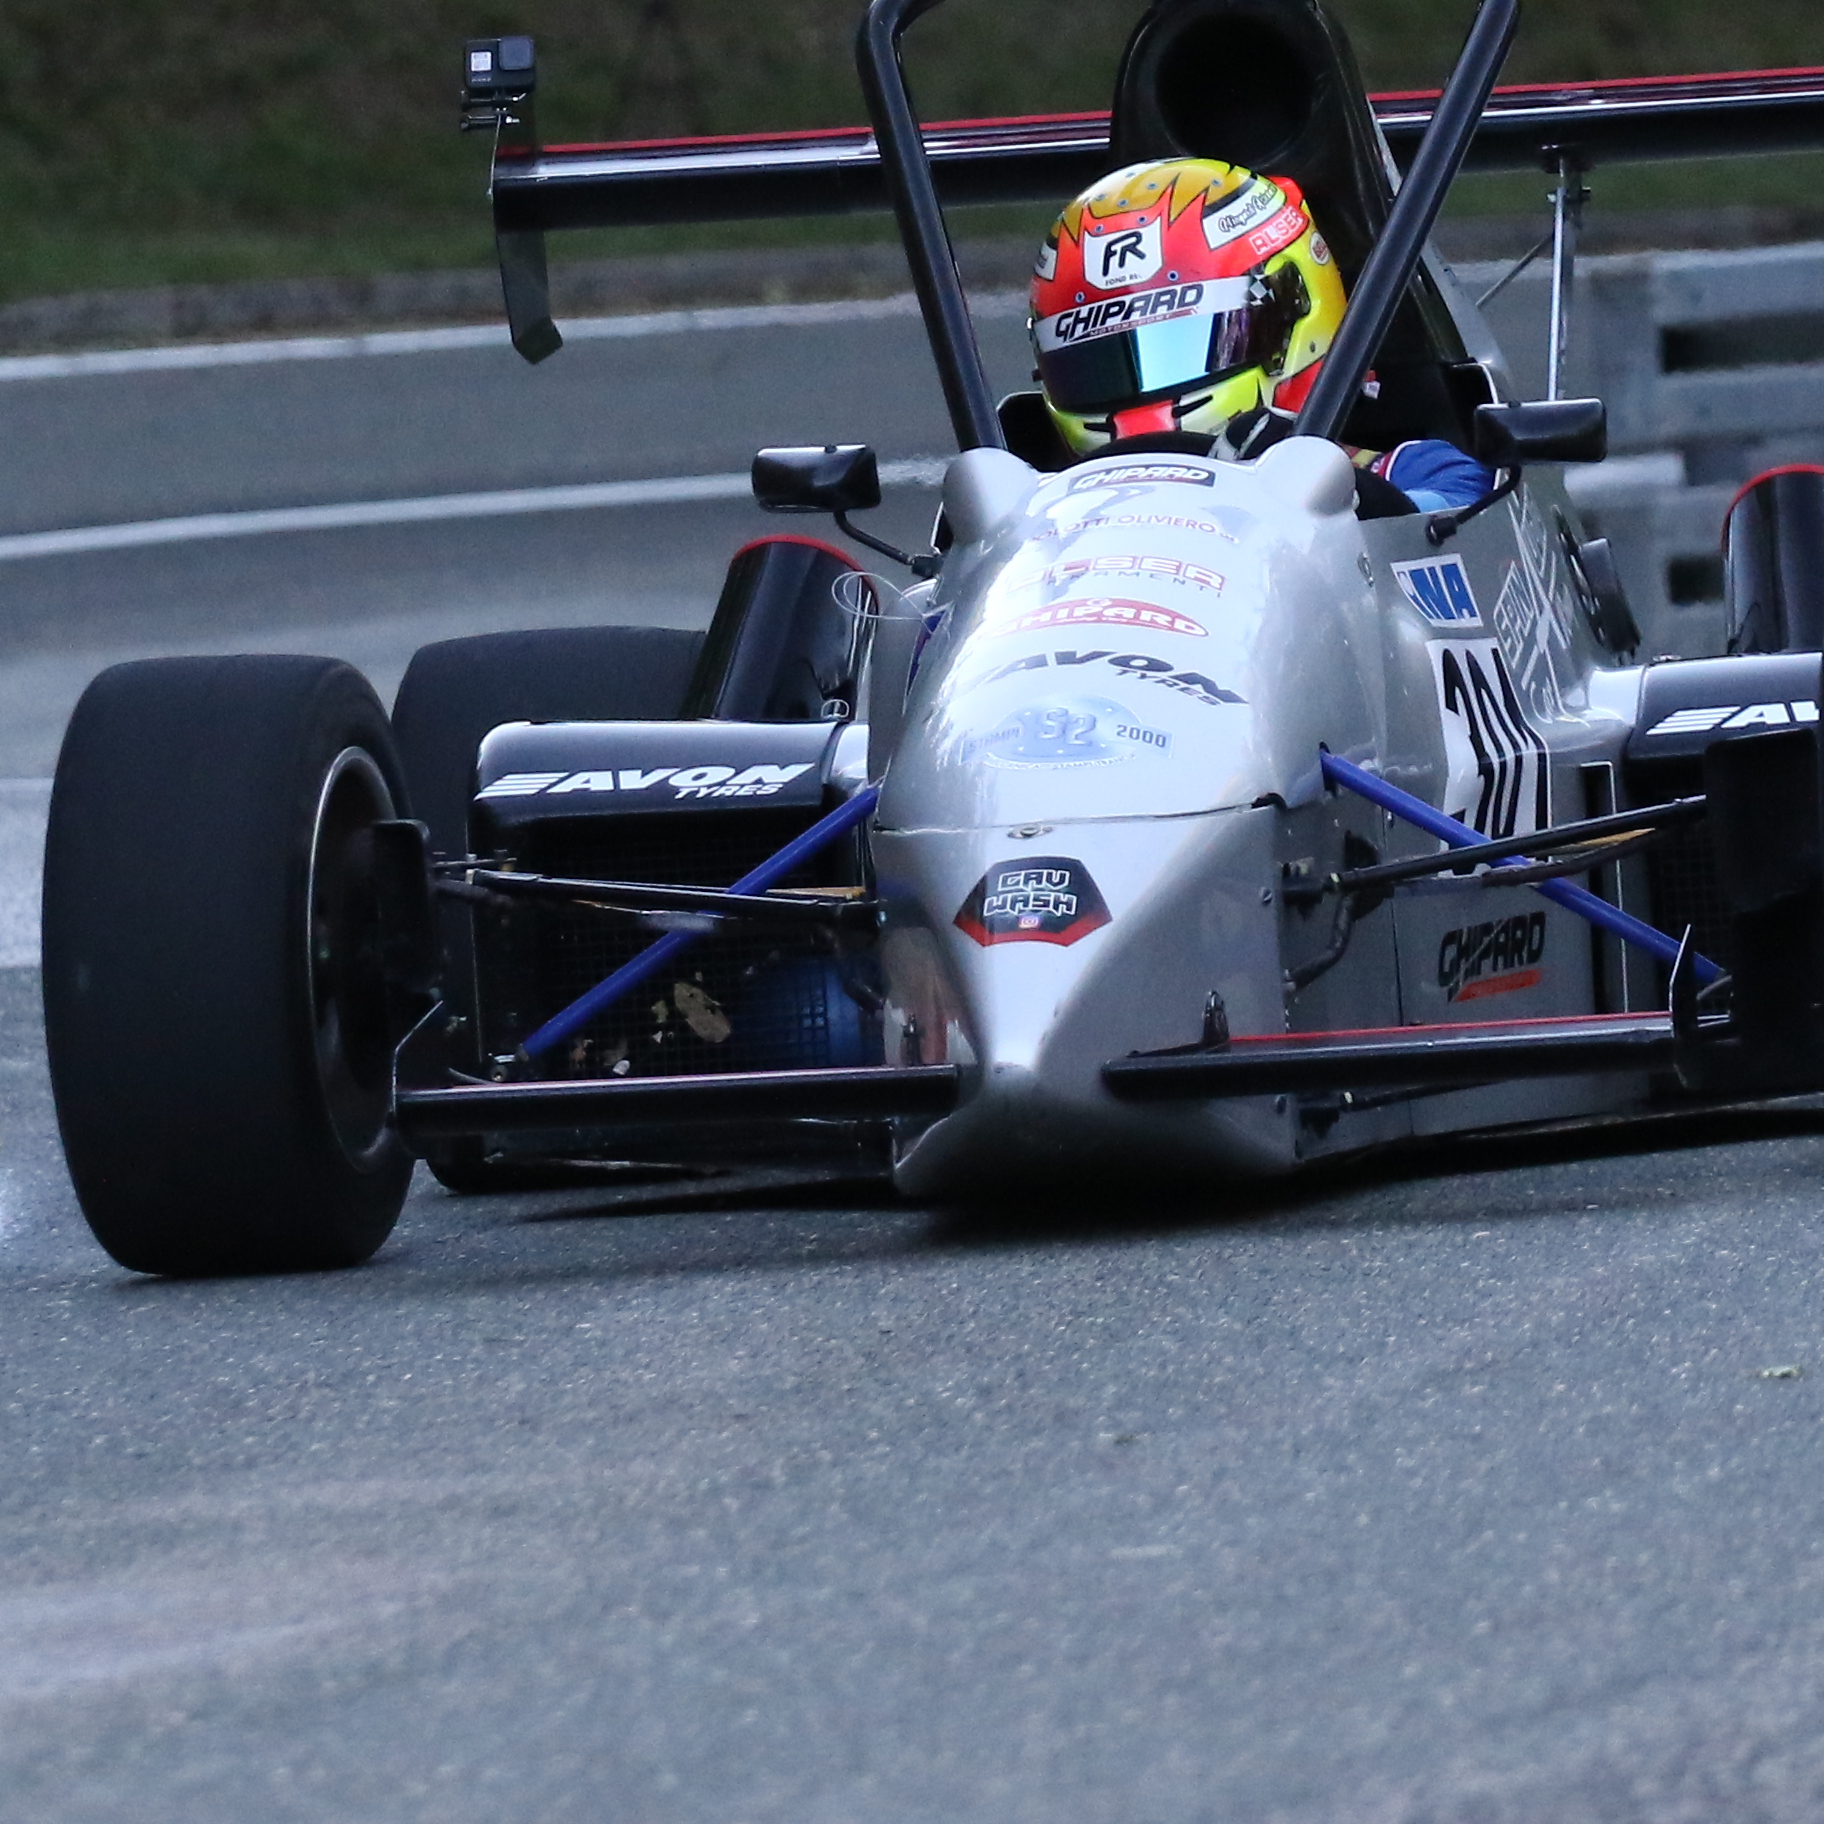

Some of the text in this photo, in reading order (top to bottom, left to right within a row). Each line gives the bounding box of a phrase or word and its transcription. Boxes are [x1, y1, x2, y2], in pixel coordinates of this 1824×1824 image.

[1249, 205, 1304, 255] ALSER
[1102, 231, 1146, 277] FR
[1056, 284, 1204, 343] GHIPARD
[1073, 466, 1209, 489] GHIPARD
[1118, 513, 1215, 534] OLIVIERO
[1004, 554, 1226, 592] ALSER
[992, 606, 1205, 637] GHIPARD
[982, 650, 1249, 705] AVON
[1116, 669, 1221, 706] TYRES
[1117, 724, 1166, 749] 2000
[546, 763, 815, 794] AVON
[675, 782, 784, 800] TYRES
[983, 891, 1076, 917] WASH
[1438, 911, 1546, 1001] GHIPARD
